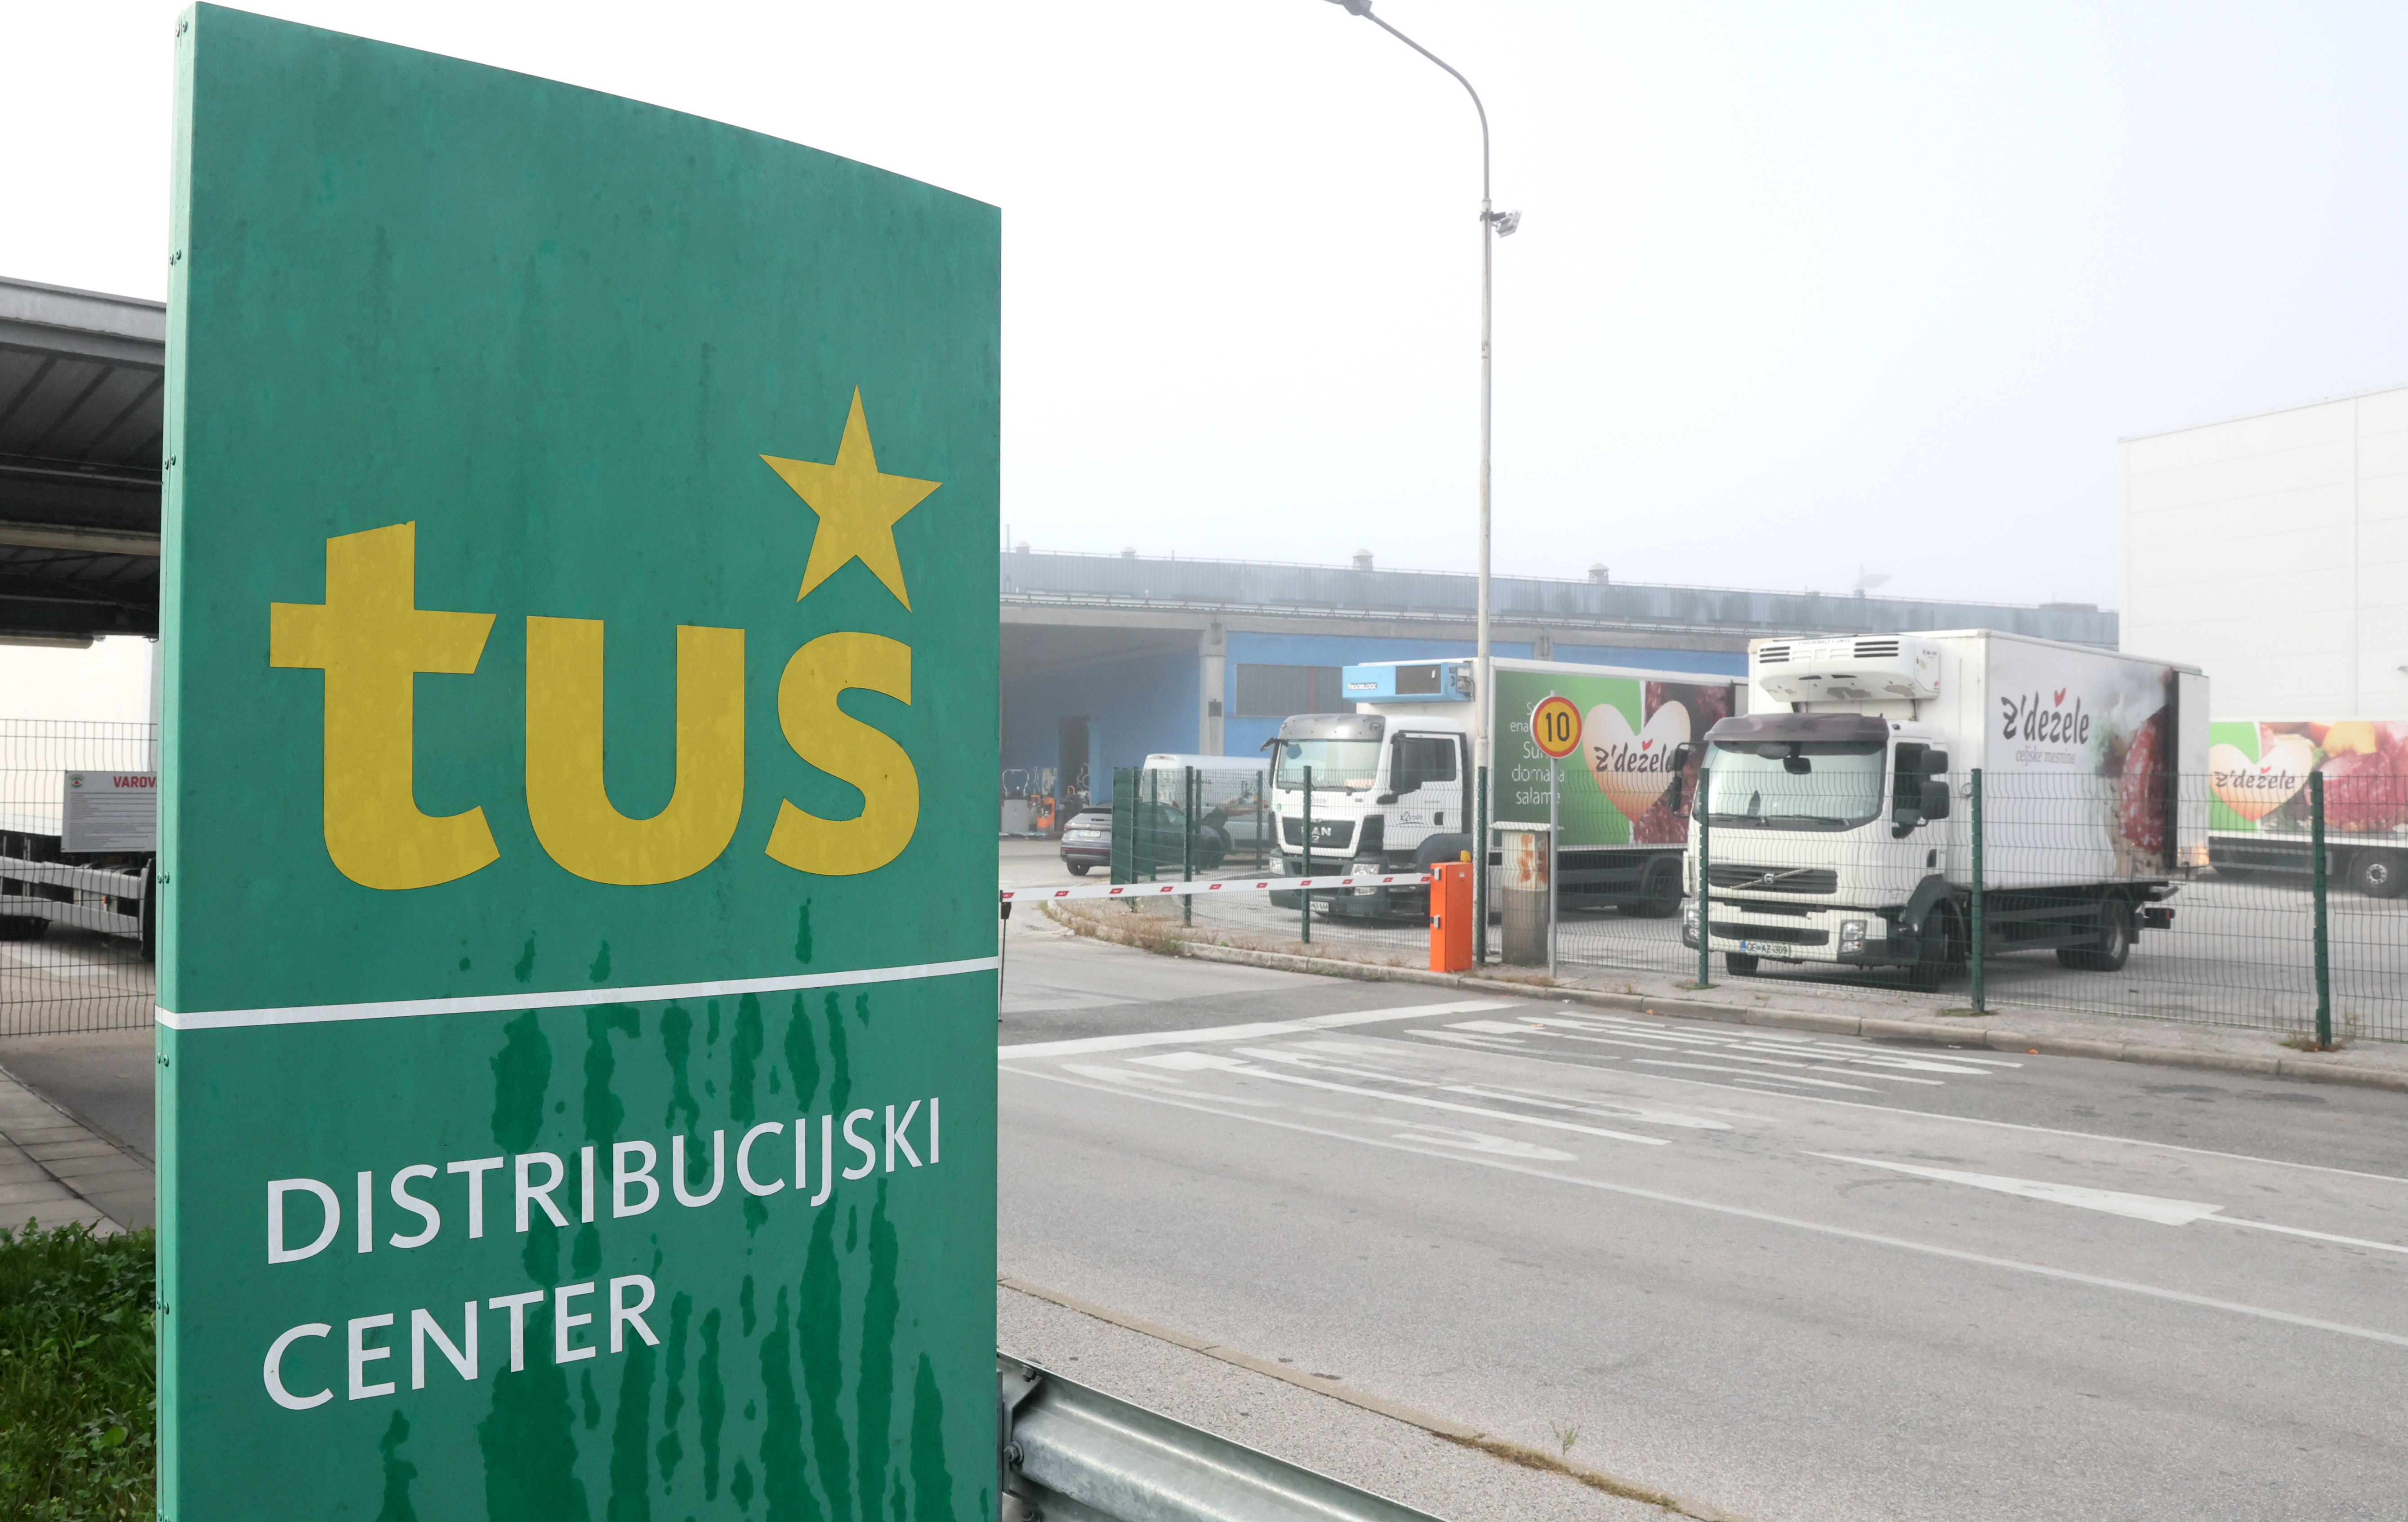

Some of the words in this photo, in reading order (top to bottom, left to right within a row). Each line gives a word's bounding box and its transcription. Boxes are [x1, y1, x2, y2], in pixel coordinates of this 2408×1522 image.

[1546, 712, 1570, 742] 10
[113, 776, 157, 788] VAROV
[1512, 763, 1565, 782] domaa
[1301, 827, 1332, 836] AN
[268, 1096, 941, 1264] DISTRIBUCIJSKI
[263, 1273, 660, 1410] CENTER
